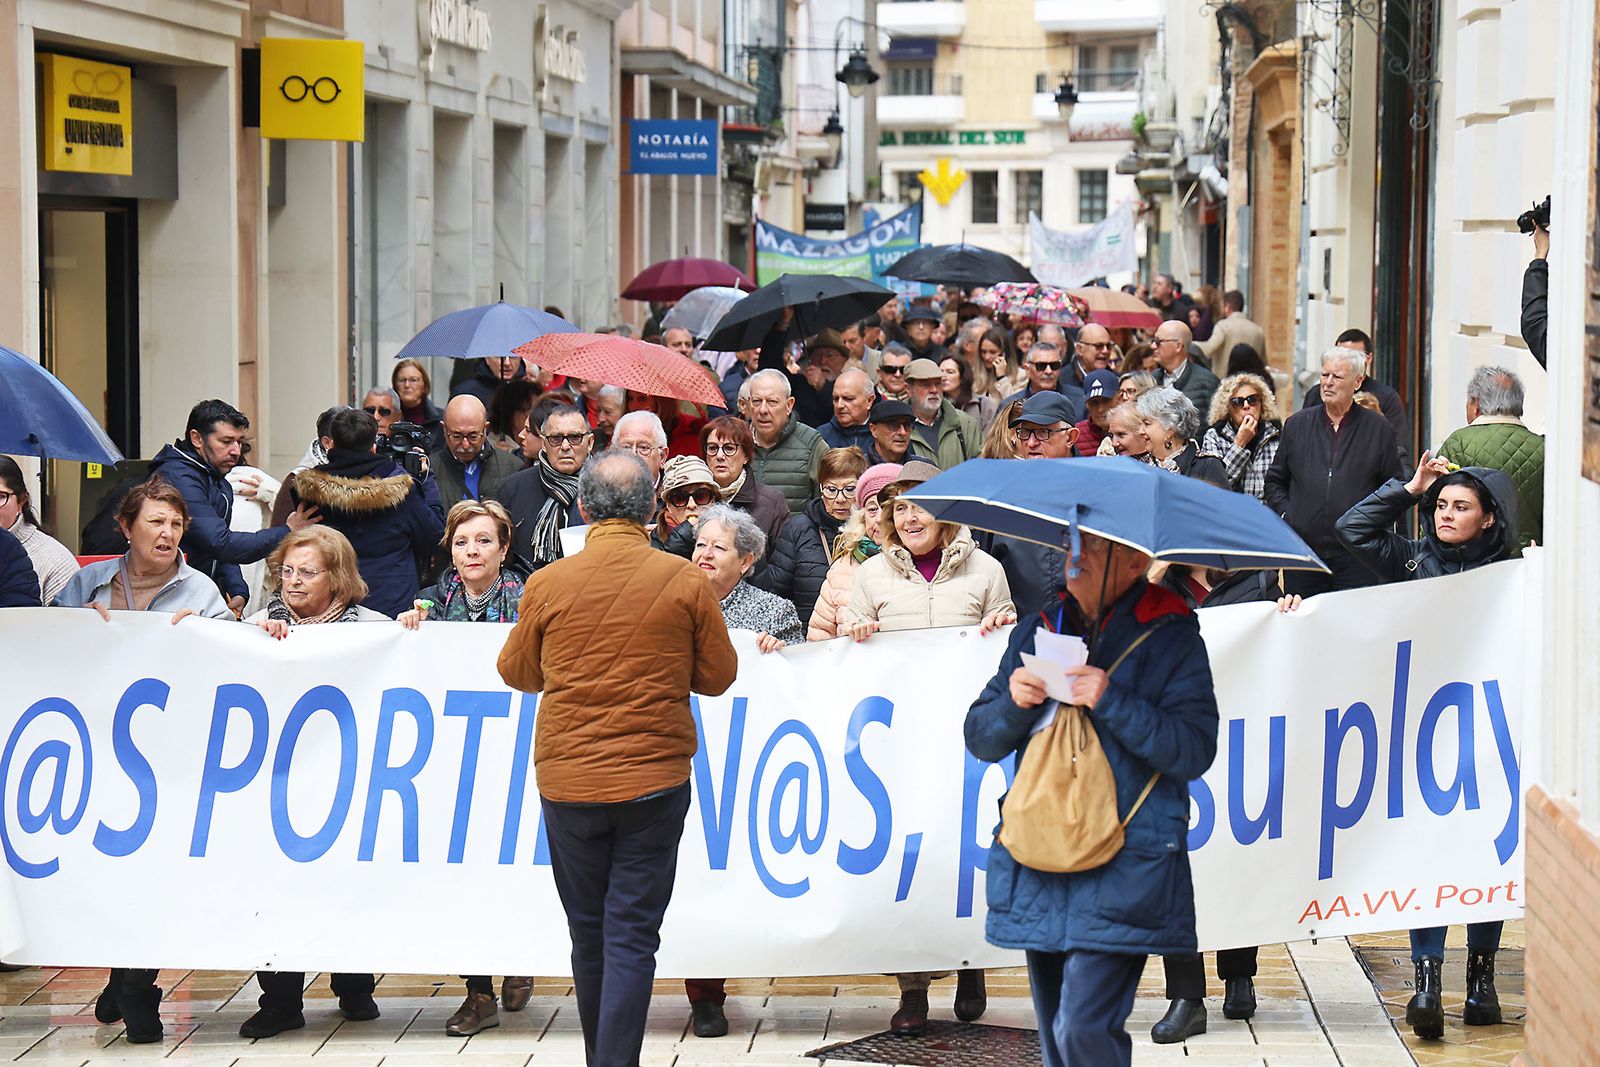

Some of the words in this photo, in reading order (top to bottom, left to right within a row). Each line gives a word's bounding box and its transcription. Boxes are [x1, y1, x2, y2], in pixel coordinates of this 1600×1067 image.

[638, 132, 709, 145] NOTARÍA
[903, 131, 953, 145] RURAL
[959, 131, 988, 145] DEL
[994, 130, 1026, 145] SUR
[1298, 888, 1421, 924] AA.VV.
[1435, 880, 1519, 909] Port
